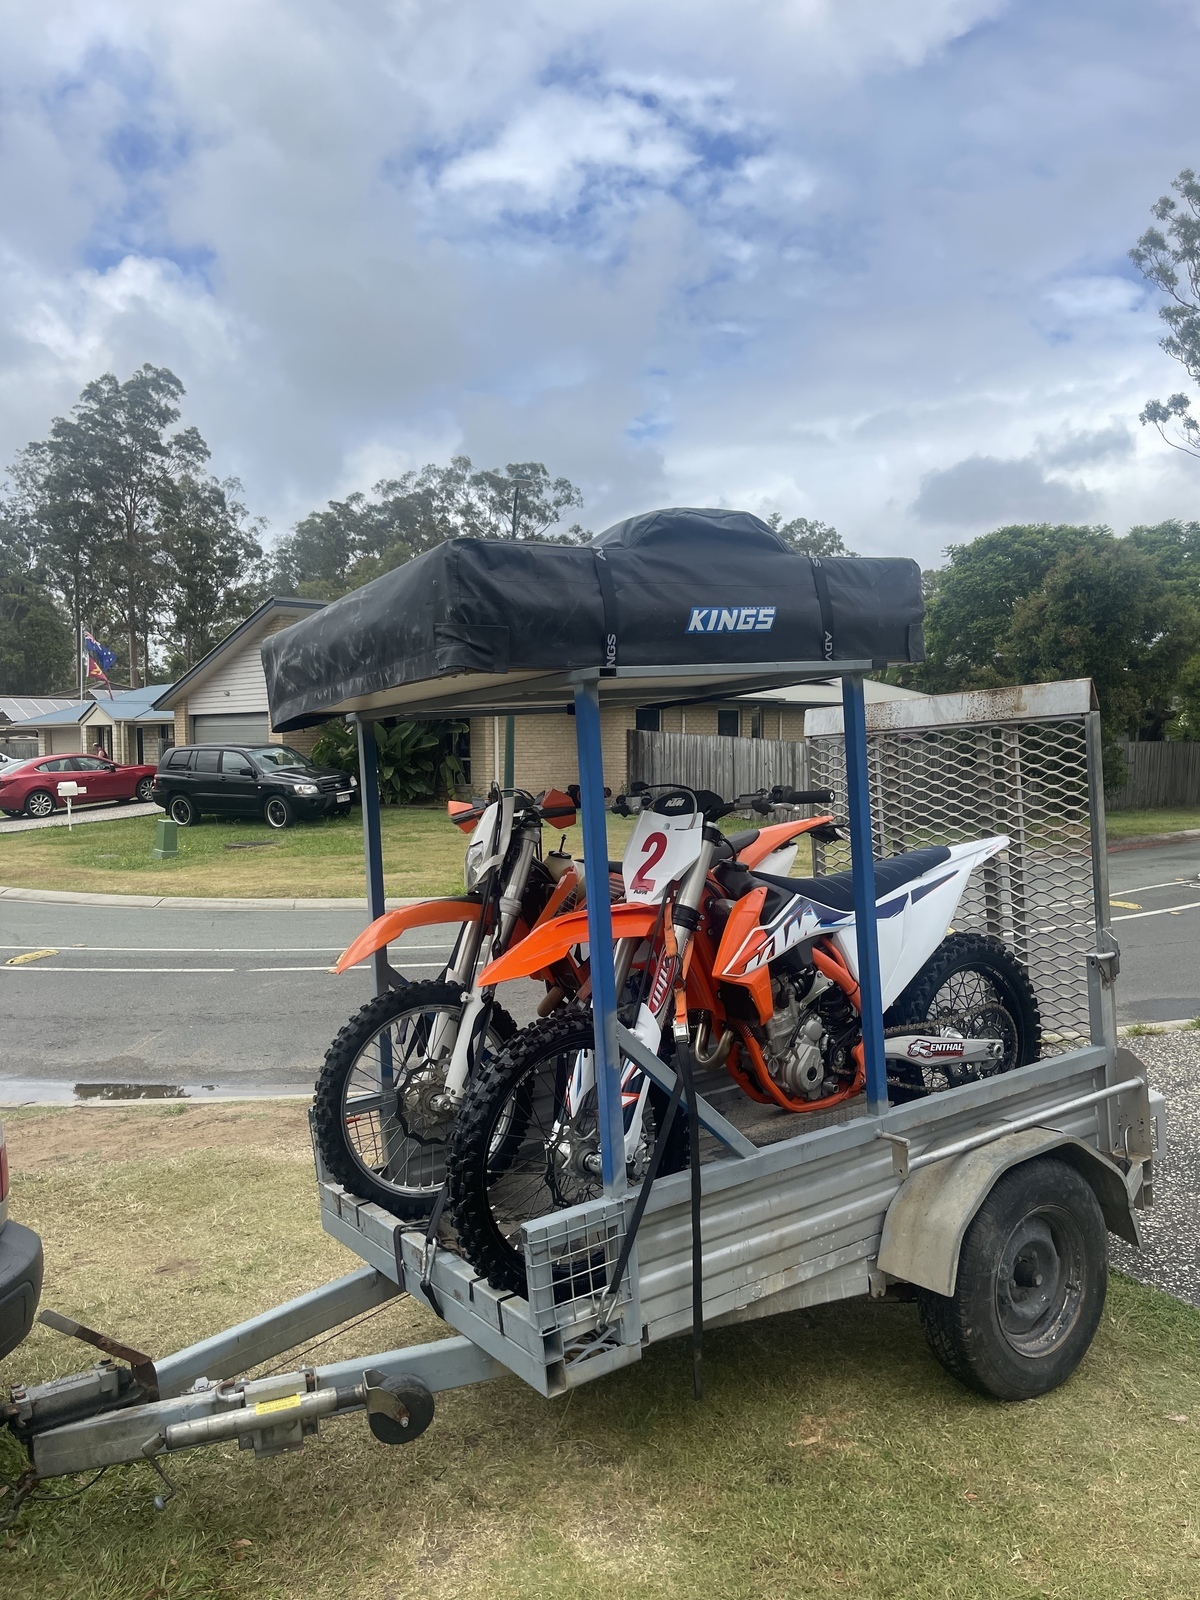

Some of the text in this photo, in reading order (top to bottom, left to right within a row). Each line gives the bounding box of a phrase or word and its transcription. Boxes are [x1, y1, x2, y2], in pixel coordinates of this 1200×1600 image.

[687, 609, 775, 631] KINGS
[664, 797, 686, 808] KTM
[630, 832, 668, 891] 2
